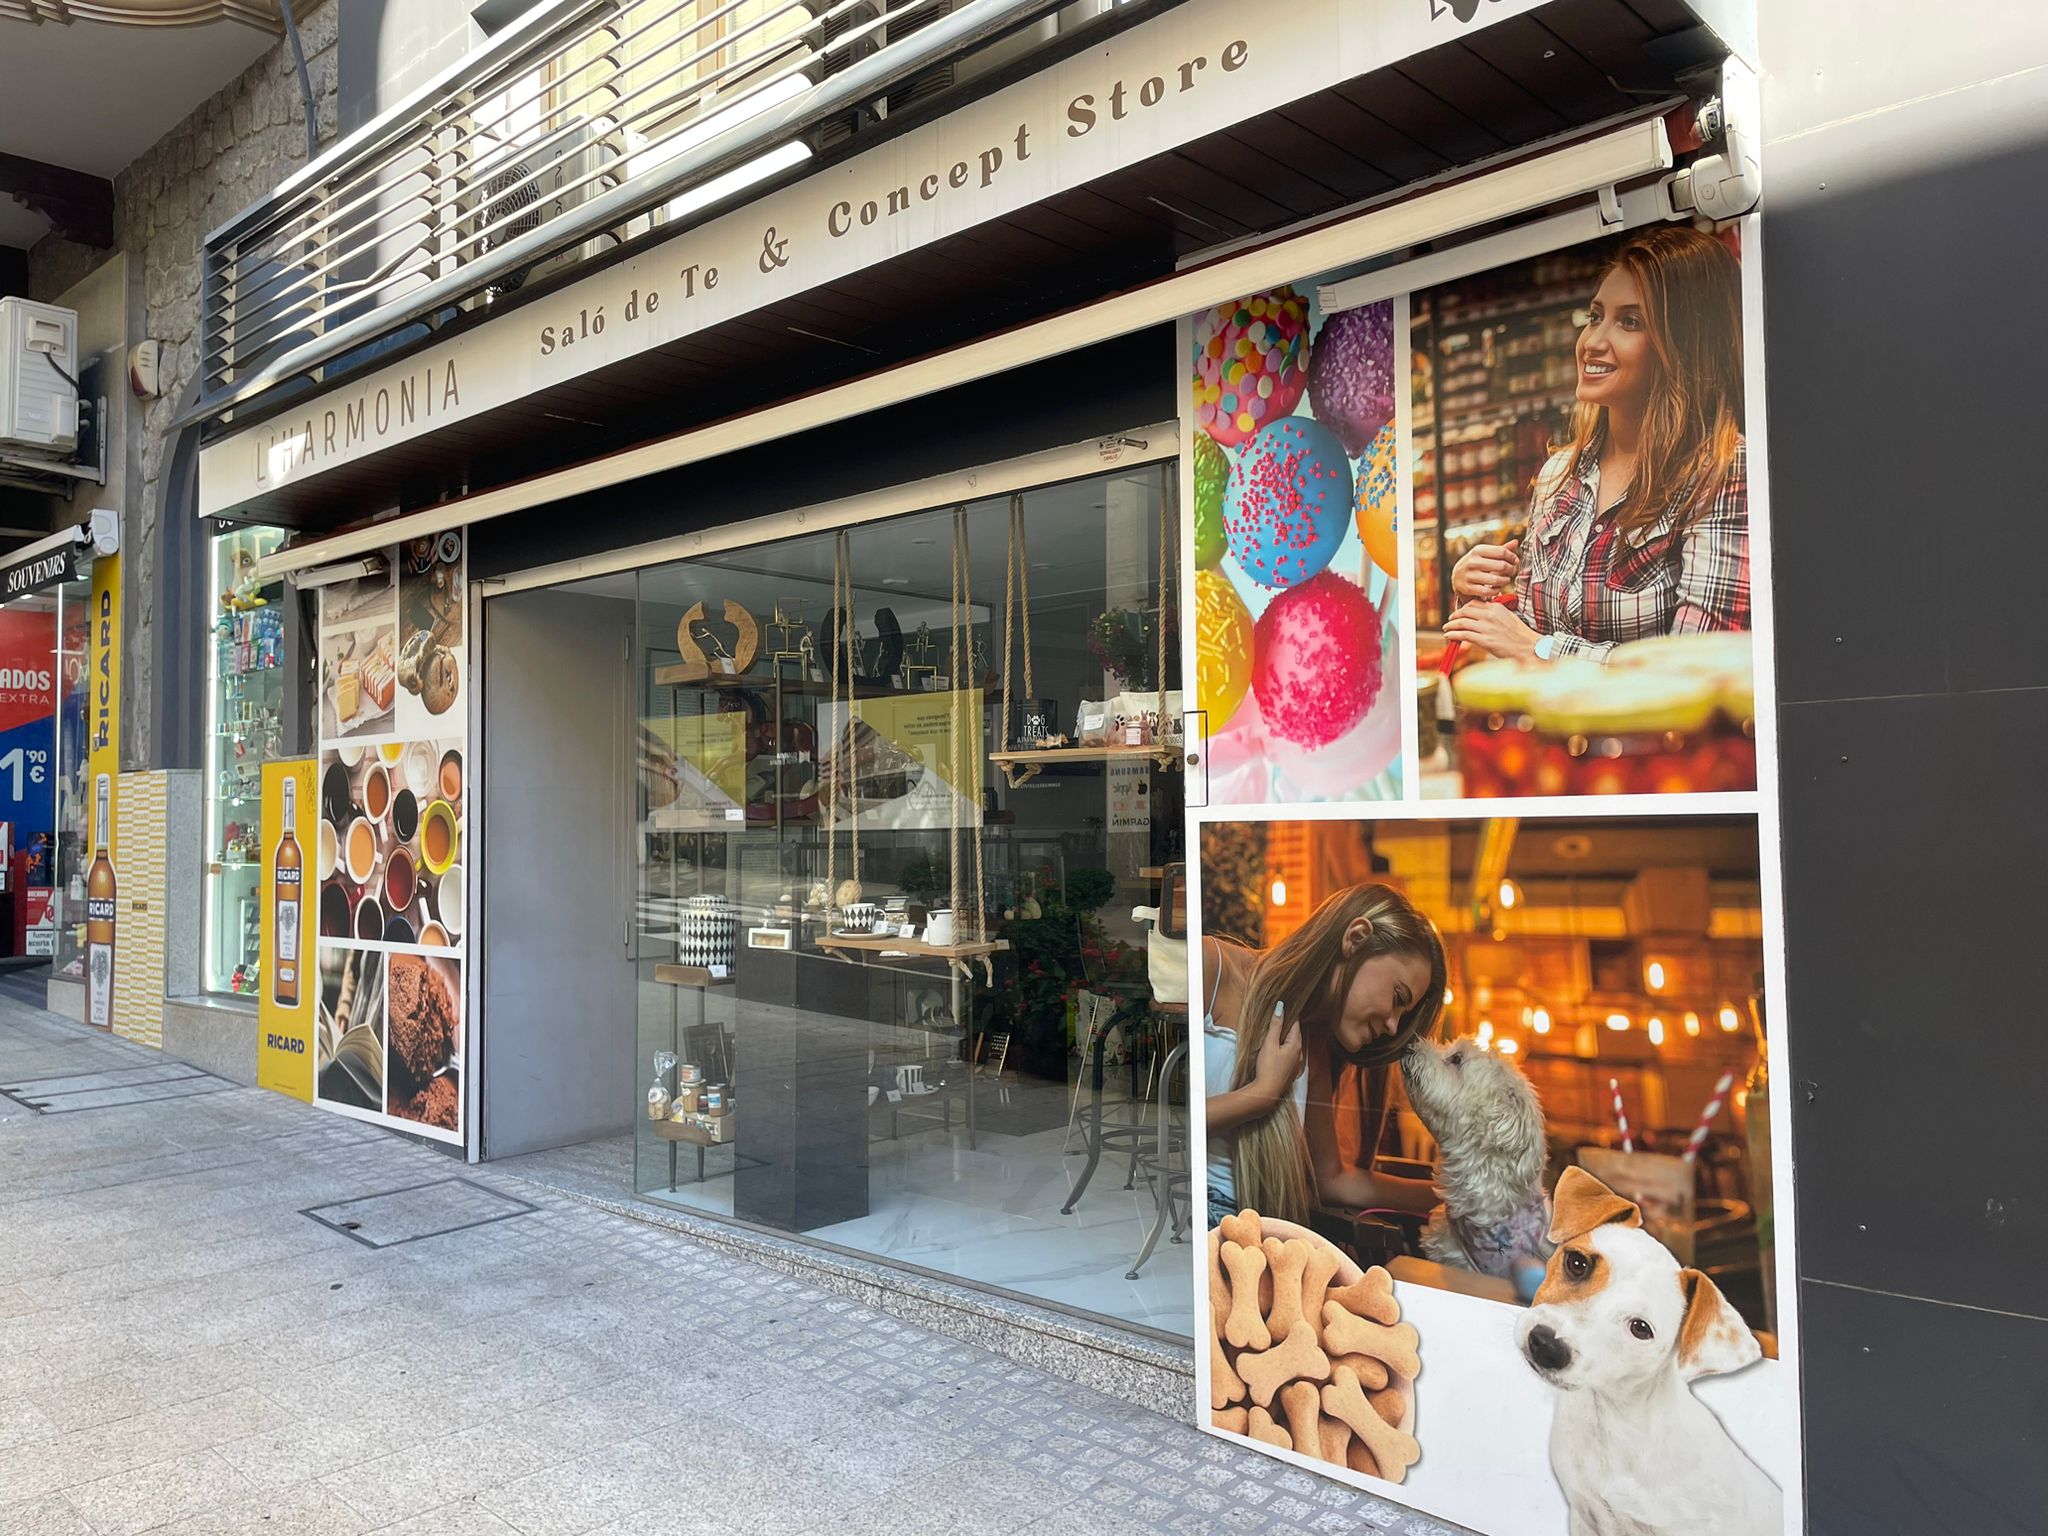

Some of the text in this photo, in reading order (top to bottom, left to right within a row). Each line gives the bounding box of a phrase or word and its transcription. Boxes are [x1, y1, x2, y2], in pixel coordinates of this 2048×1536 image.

[540, 39, 1249, 356] Saló de Te & Concept Store
[7, 552, 67, 593] SOUVENIRS
[99, 590, 111, 748] RICARD
[0, 692, 50, 705] EXTRA
[1023, 725, 1049, 738] TREATS
[277, 870, 300, 881] RICARD
[88, 902, 114, 916] RICARD
[267, 1033, 305, 1055] RICARD
